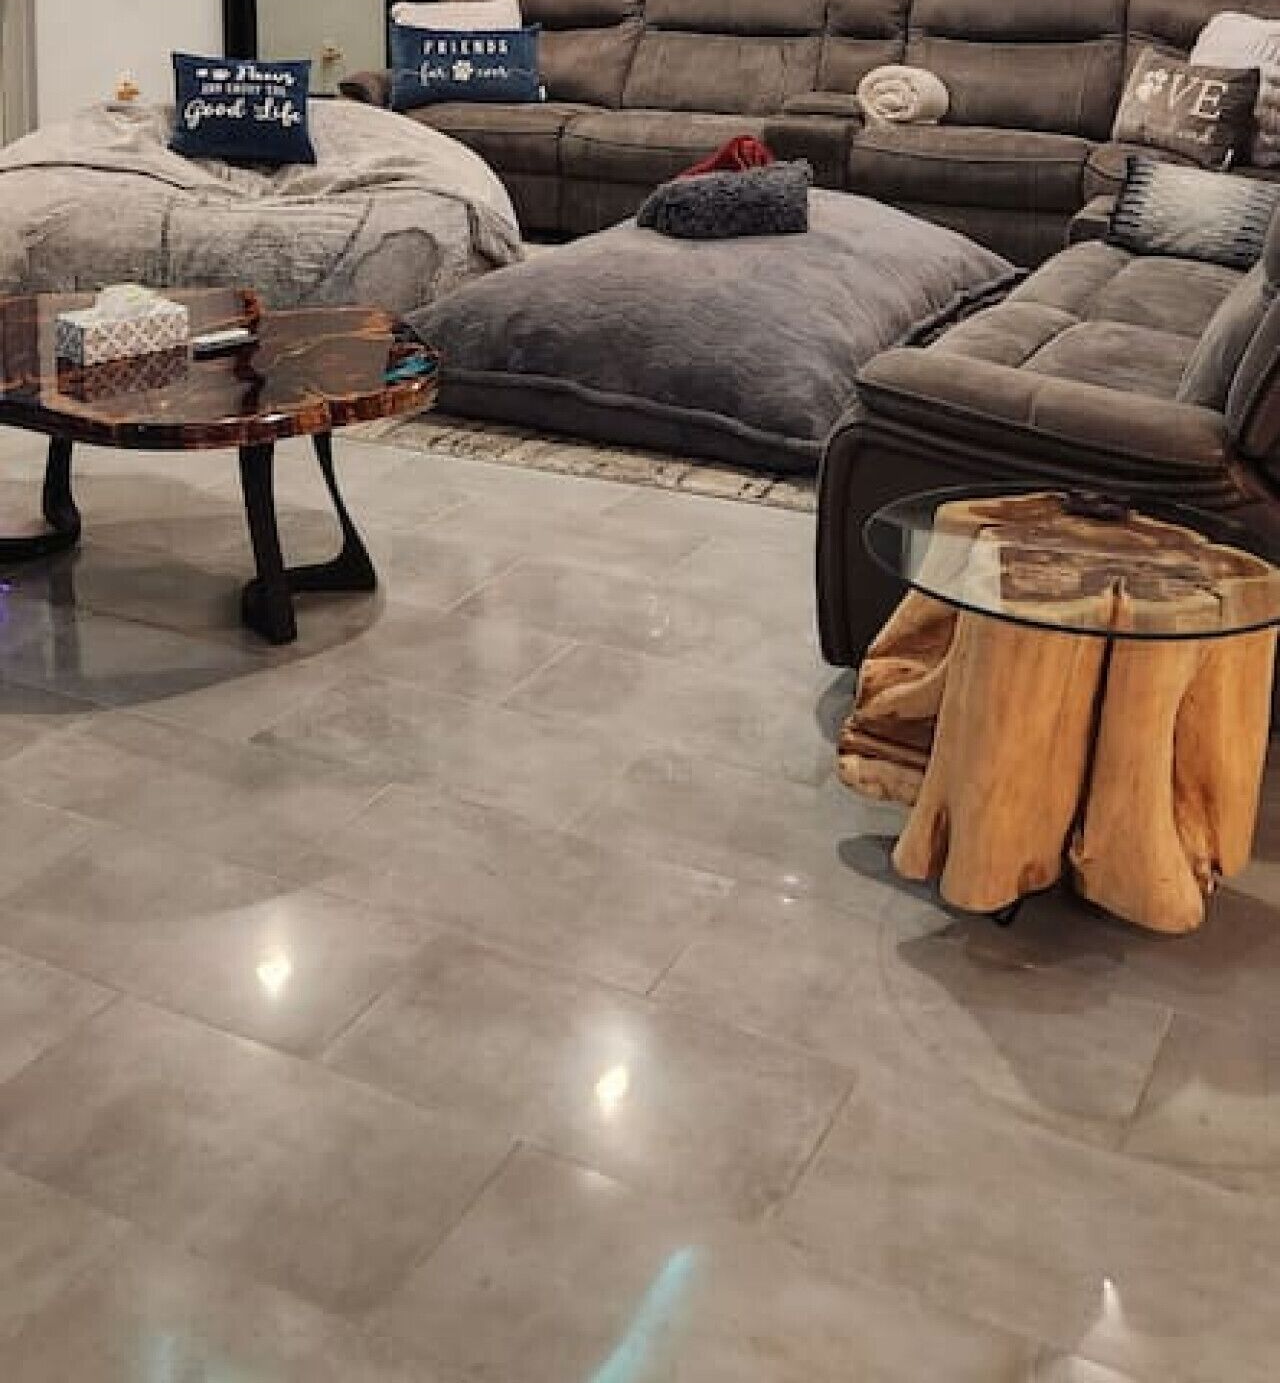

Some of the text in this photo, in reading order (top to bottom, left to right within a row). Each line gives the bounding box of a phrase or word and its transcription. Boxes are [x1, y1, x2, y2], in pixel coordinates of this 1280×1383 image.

[423, 39, 508, 56] FRIENDS
[183, 97, 302, 130] Good Life
